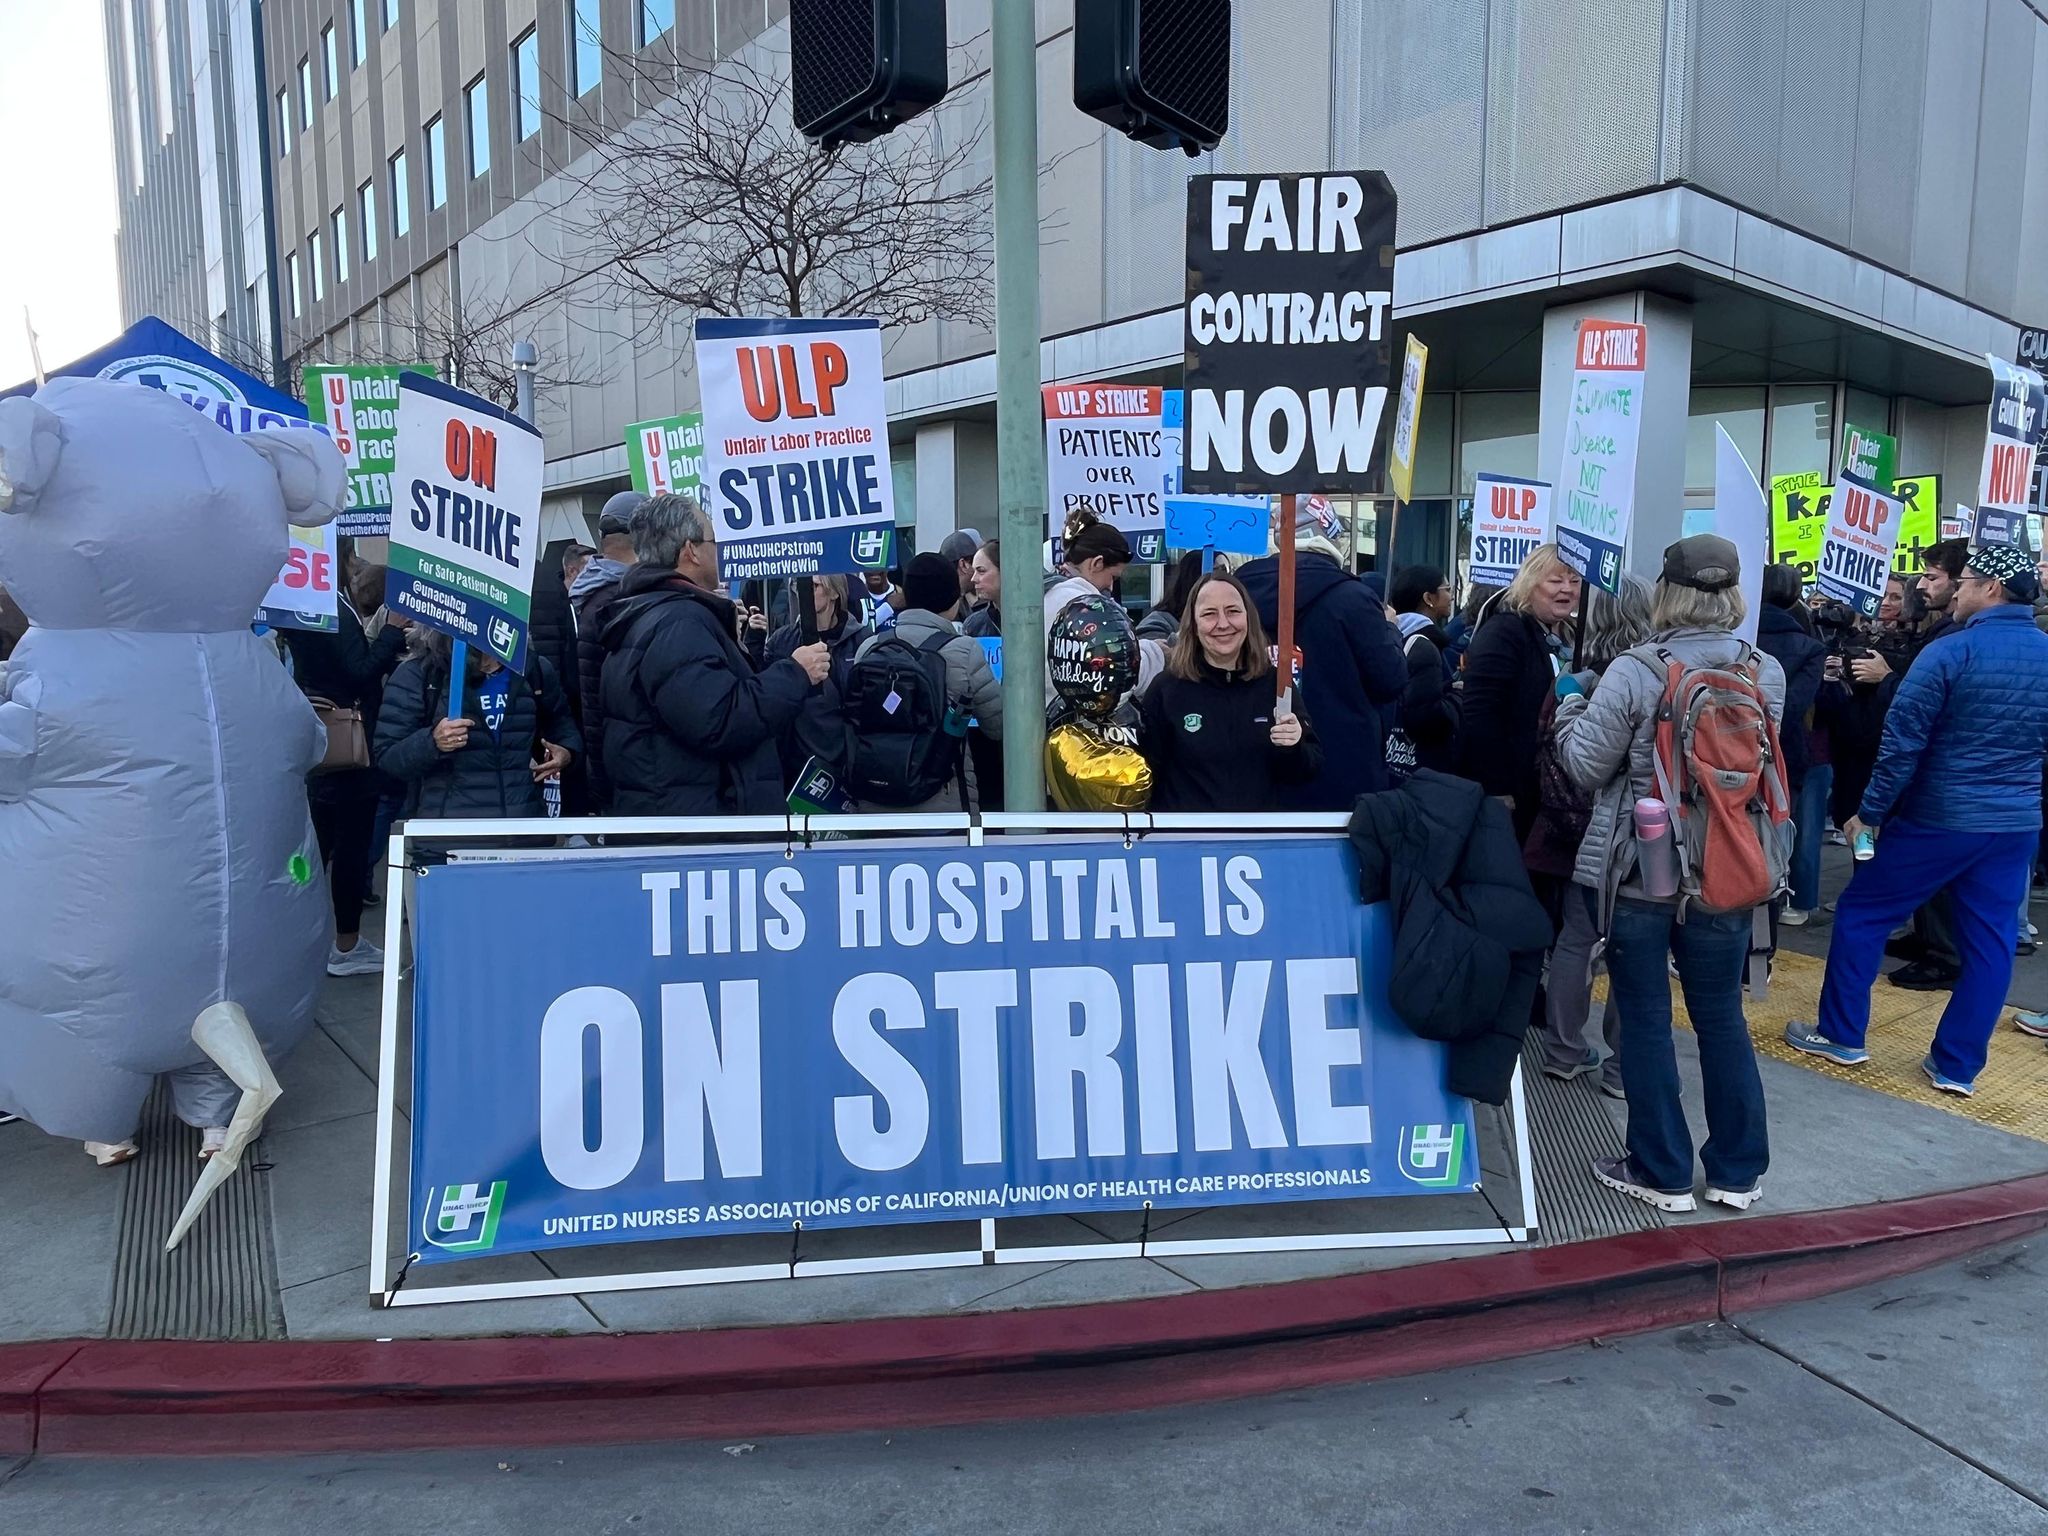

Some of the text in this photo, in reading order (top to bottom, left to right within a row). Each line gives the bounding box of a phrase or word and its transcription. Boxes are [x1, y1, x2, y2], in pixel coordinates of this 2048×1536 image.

[1211, 176, 1364, 253] FAIR
[1191, 291, 1391, 345] CONTRACT
[1583, 329, 1638, 366] ULP STRIKE
[736, 342, 848, 422] ULP
[1057, 389, 1149, 416] ULP STRIKE
[724, 426, 871, 456] Unfair Labor Practice
[1059, 428, 1162, 457] PATIENTS
[1190, 386, 1389, 475] NOW
[446, 418, 496, 493] ON
[1086, 466, 1135, 485] OVER
[1580, 460, 1606, 491] NOT
[1988, 444, 2030, 505] NOW
[719, 455, 882, 530] STRIKE
[1063, 493, 1160, 517] PROFITS
[1492, 486, 1536, 521] ULP
[1774, 472, 1819, 494] THE
[411, 479, 521, 568] STRIKE
[1568, 490, 1618, 535] UNIONS
[1844, 488, 1889, 536] ULP
[723, 541, 823, 560] #UNACUHCPstrong
[724, 557, 819, 578] #TogetherWeWin
[1823, 540, 1885, 591] STRIKE
[413, 580, 467, 615] @unacuhcp
[418, 558, 508, 604] For Safe Patient Care
[398, 591, 478, 636] #TogetherWeRise
[1053, 636, 1088, 661] HAPPY
[641, 855, 1265, 957] THIS HOSPITAL IS
[540, 957, 1373, 1190] ON STRIKE
[543, 1168, 1371, 1236] UNITED NURSES ASSOCIATIONS OF CALIFORNIA/UNION OF HEALTH CARE PROFESSIONALS
